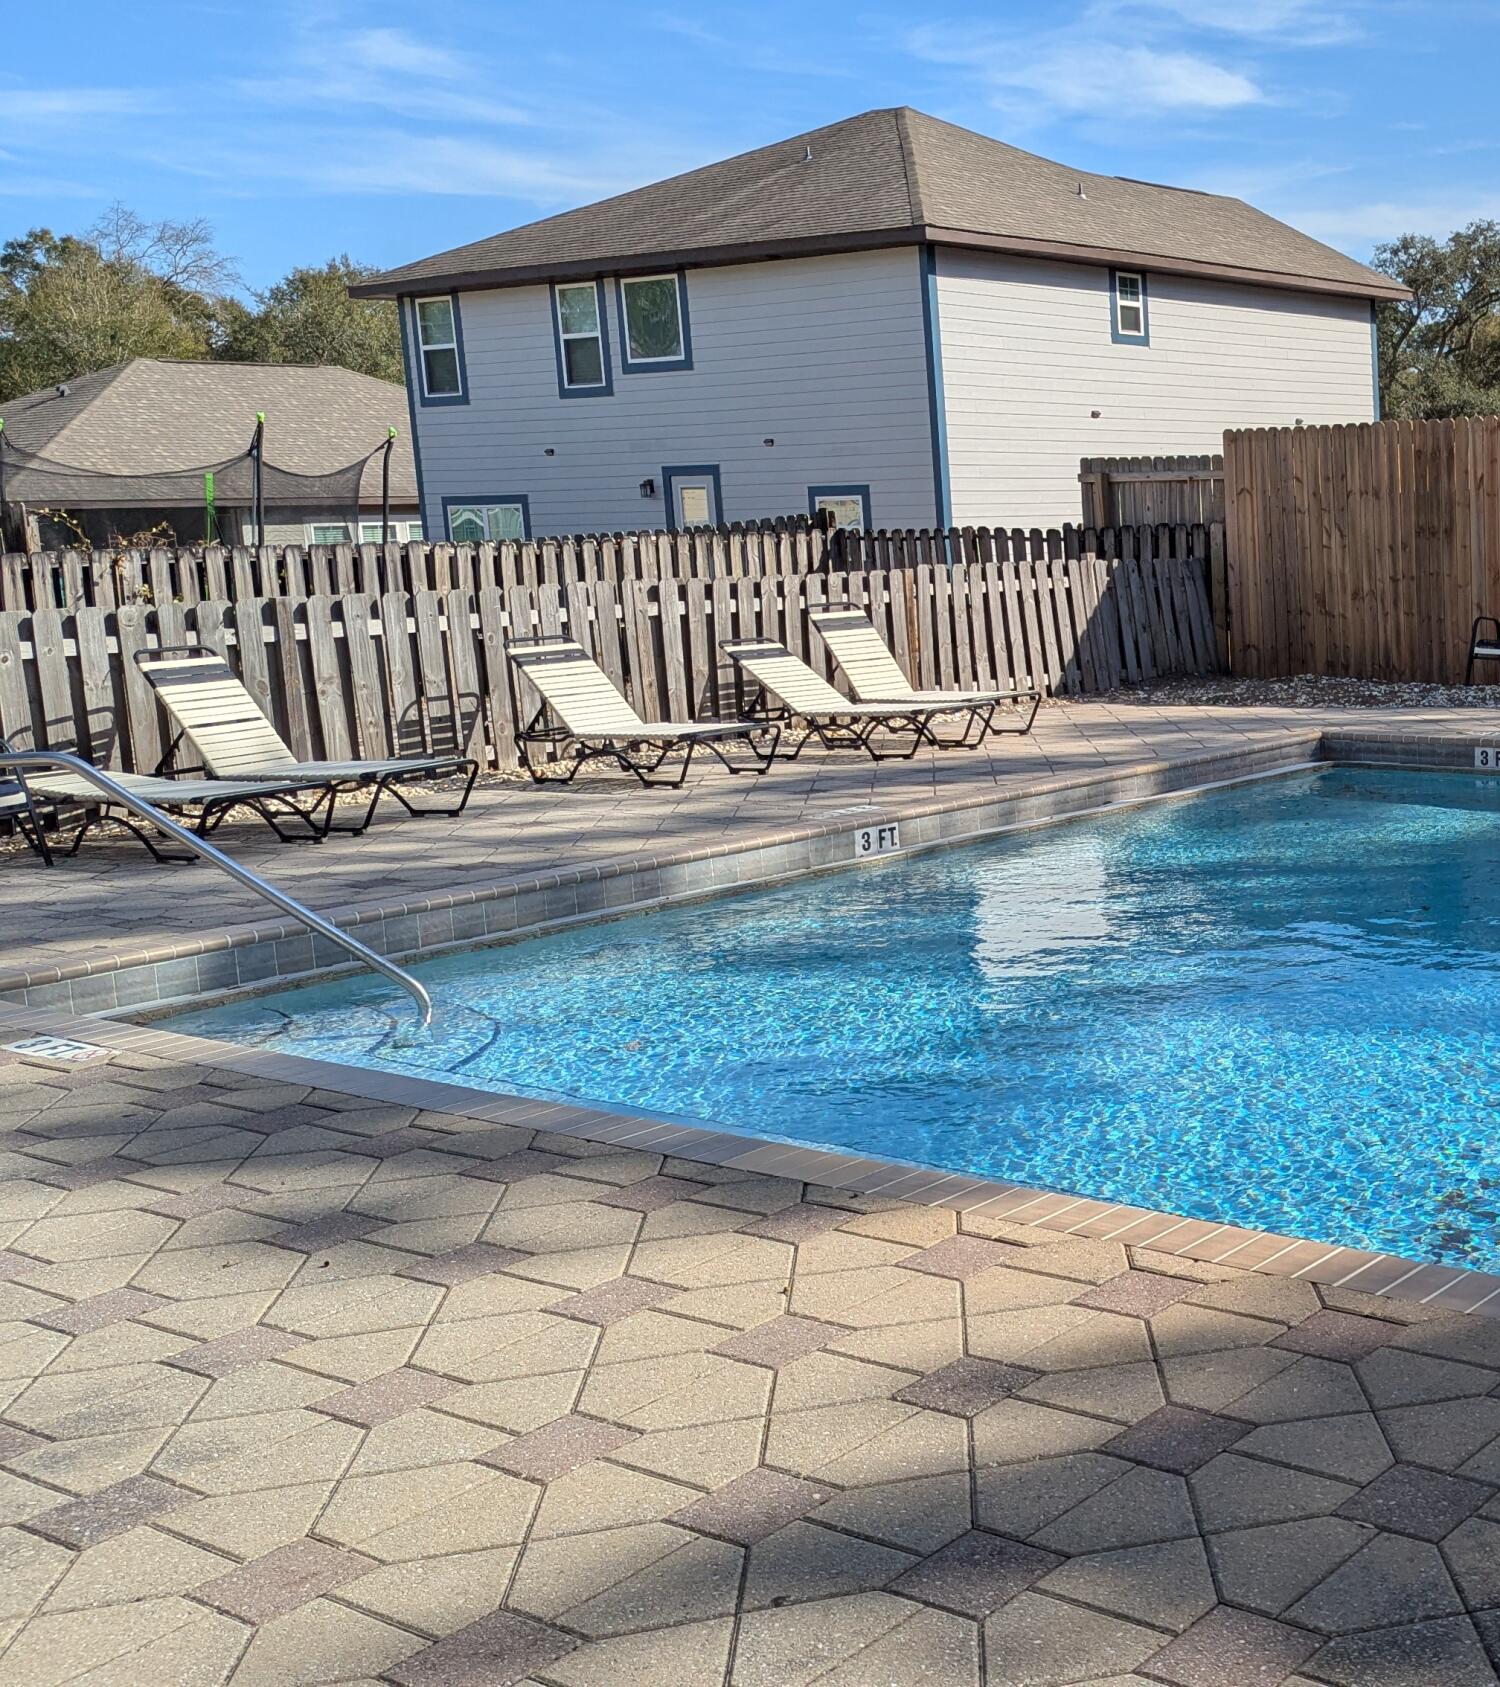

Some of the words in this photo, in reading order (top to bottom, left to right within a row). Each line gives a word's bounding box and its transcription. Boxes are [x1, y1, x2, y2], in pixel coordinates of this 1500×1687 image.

[1480, 750, 1489, 766] 3
[861, 831, 871, 852] 3
[878, 826, 898, 849] FT.
[14, 1039, 54, 1050] 3
